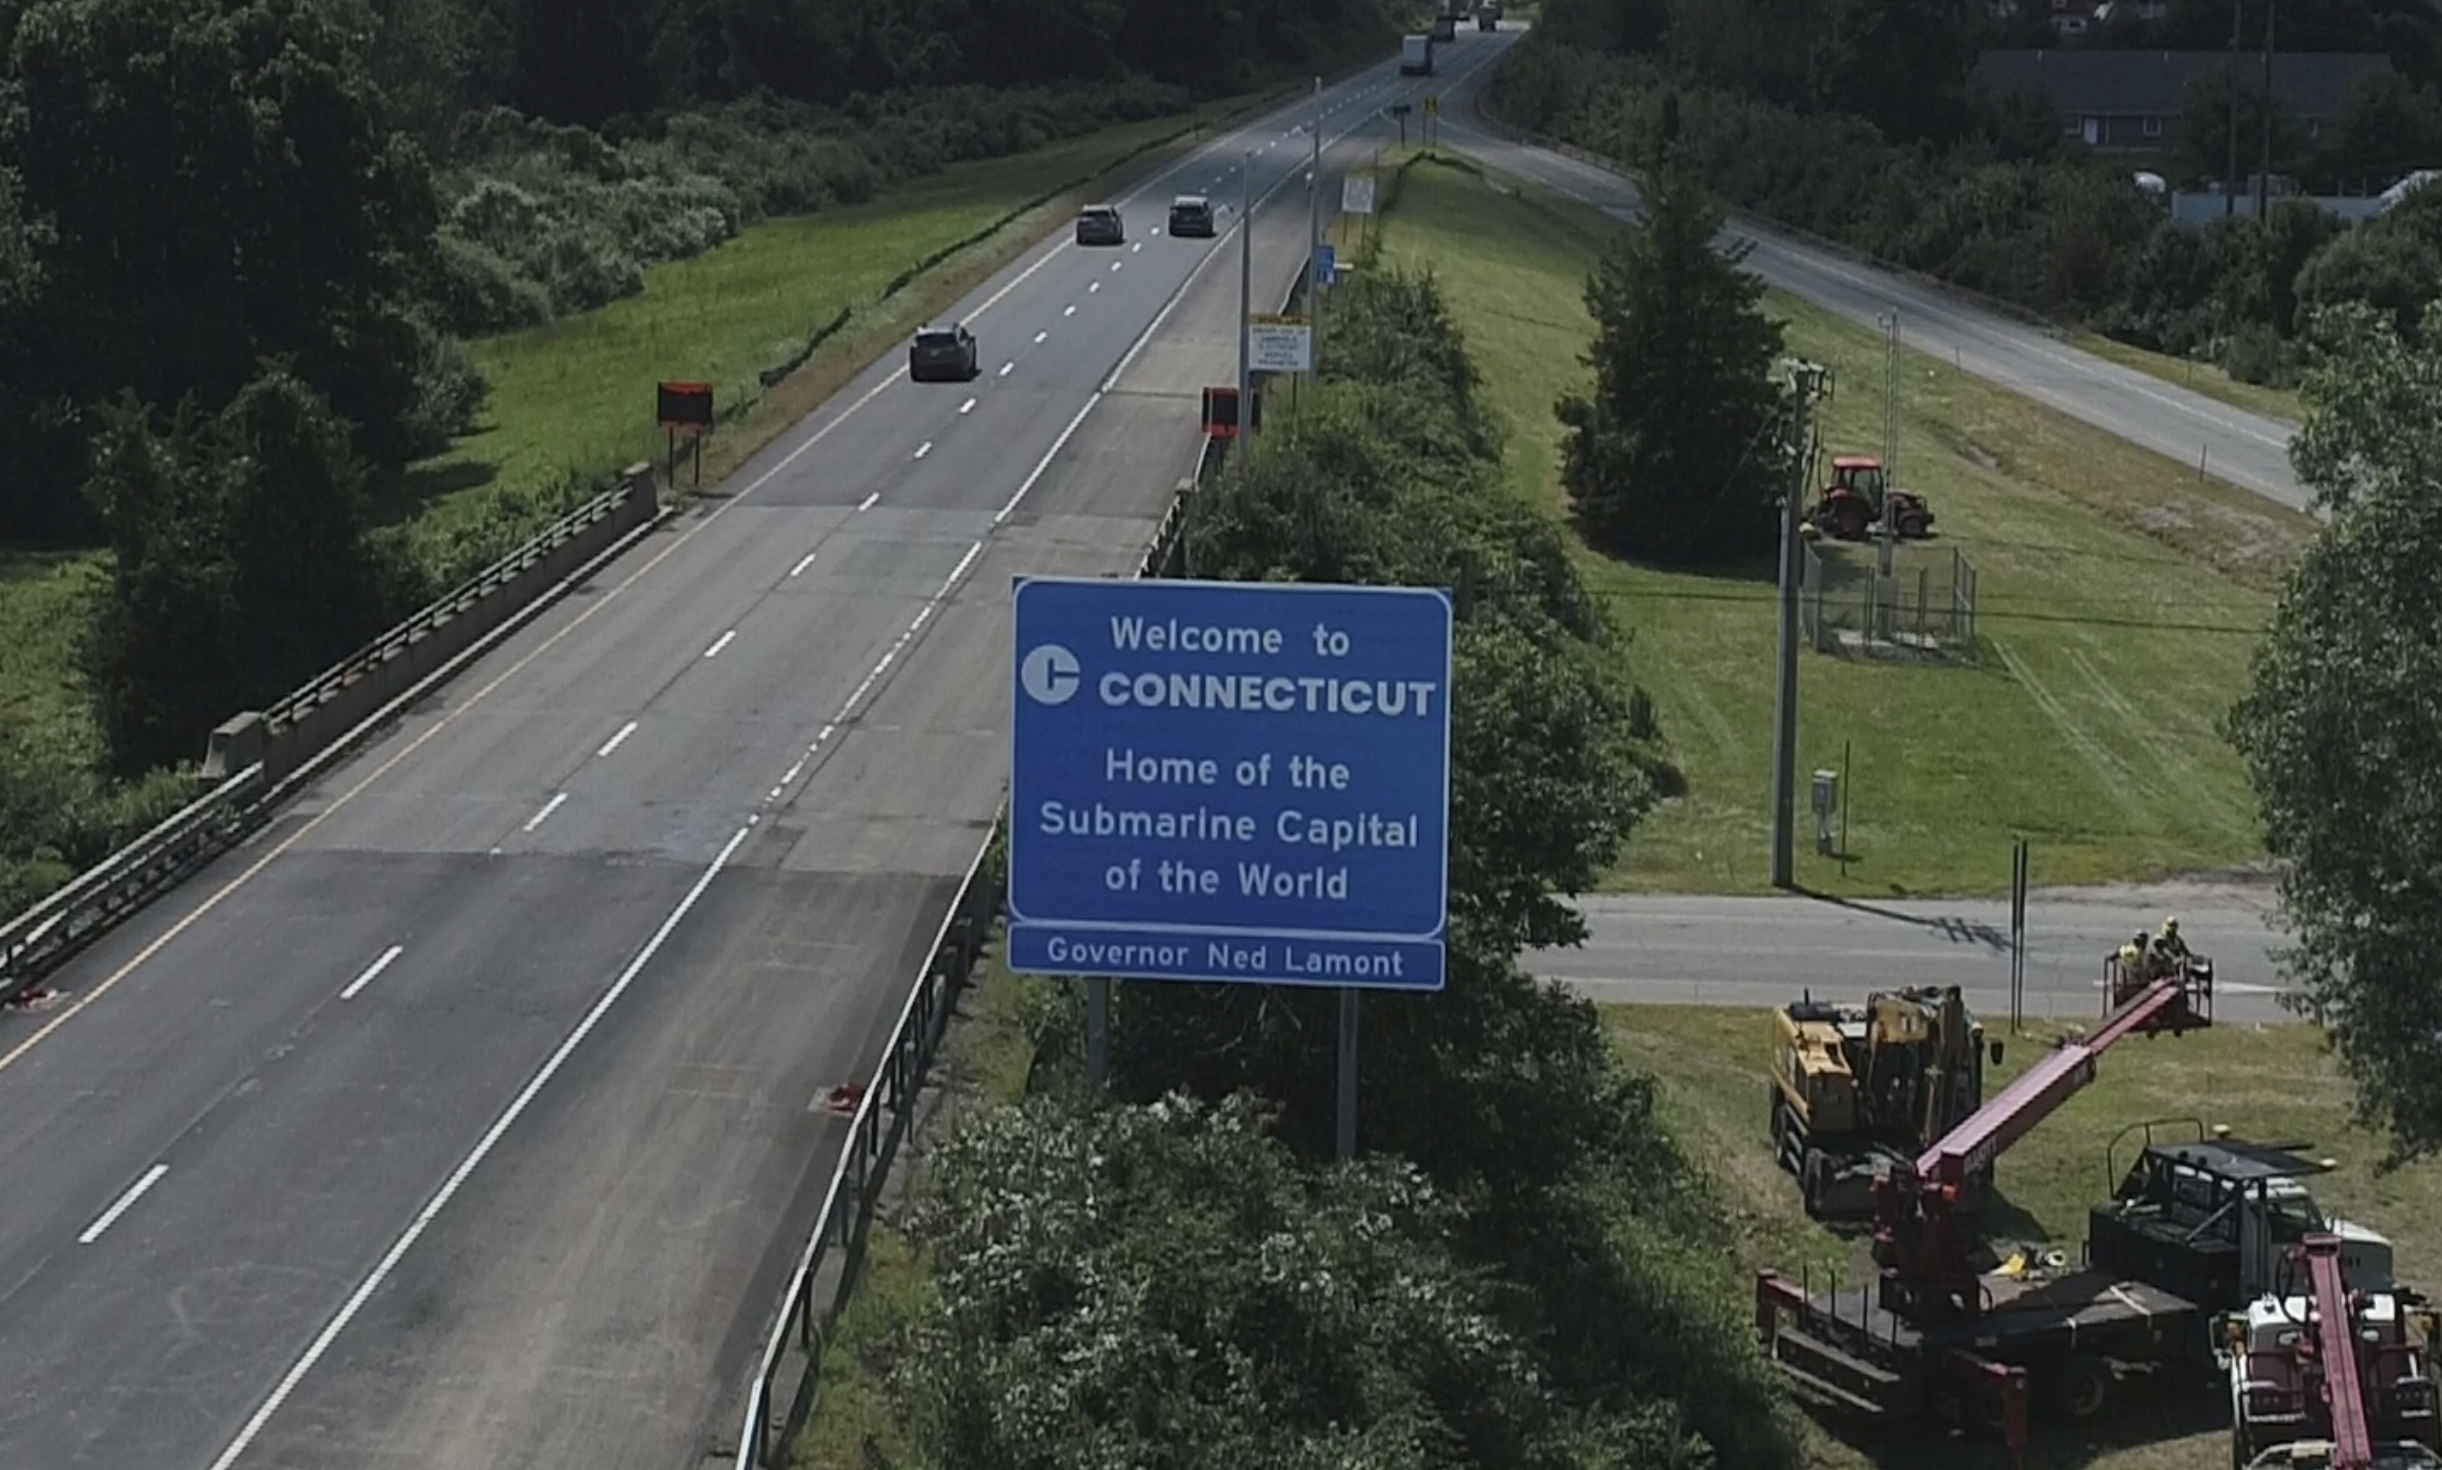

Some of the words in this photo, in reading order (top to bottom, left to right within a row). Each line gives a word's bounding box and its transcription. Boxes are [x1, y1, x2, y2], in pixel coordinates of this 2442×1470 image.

[1110, 615, 1283, 654] Welcome
[1313, 623, 1350, 656] to
[1099, 672, 1436, 716] CONNECTICUT
[1106, 748, 1218, 784] Home
[1236, 753, 1271, 787] of
[1289, 755, 1350, 790] the
[1040, 802, 1256, 841] Submarine
[1276, 810, 1418, 852] Capital
[1106, 858, 1141, 892] of
[1158, 860, 1219, 893] the
[1238, 863, 1347, 899] World
[1047, 936, 1189, 966] Governor
[1208, 943, 1267, 970] Ned
[1285, 946, 1403, 976] Lamont
